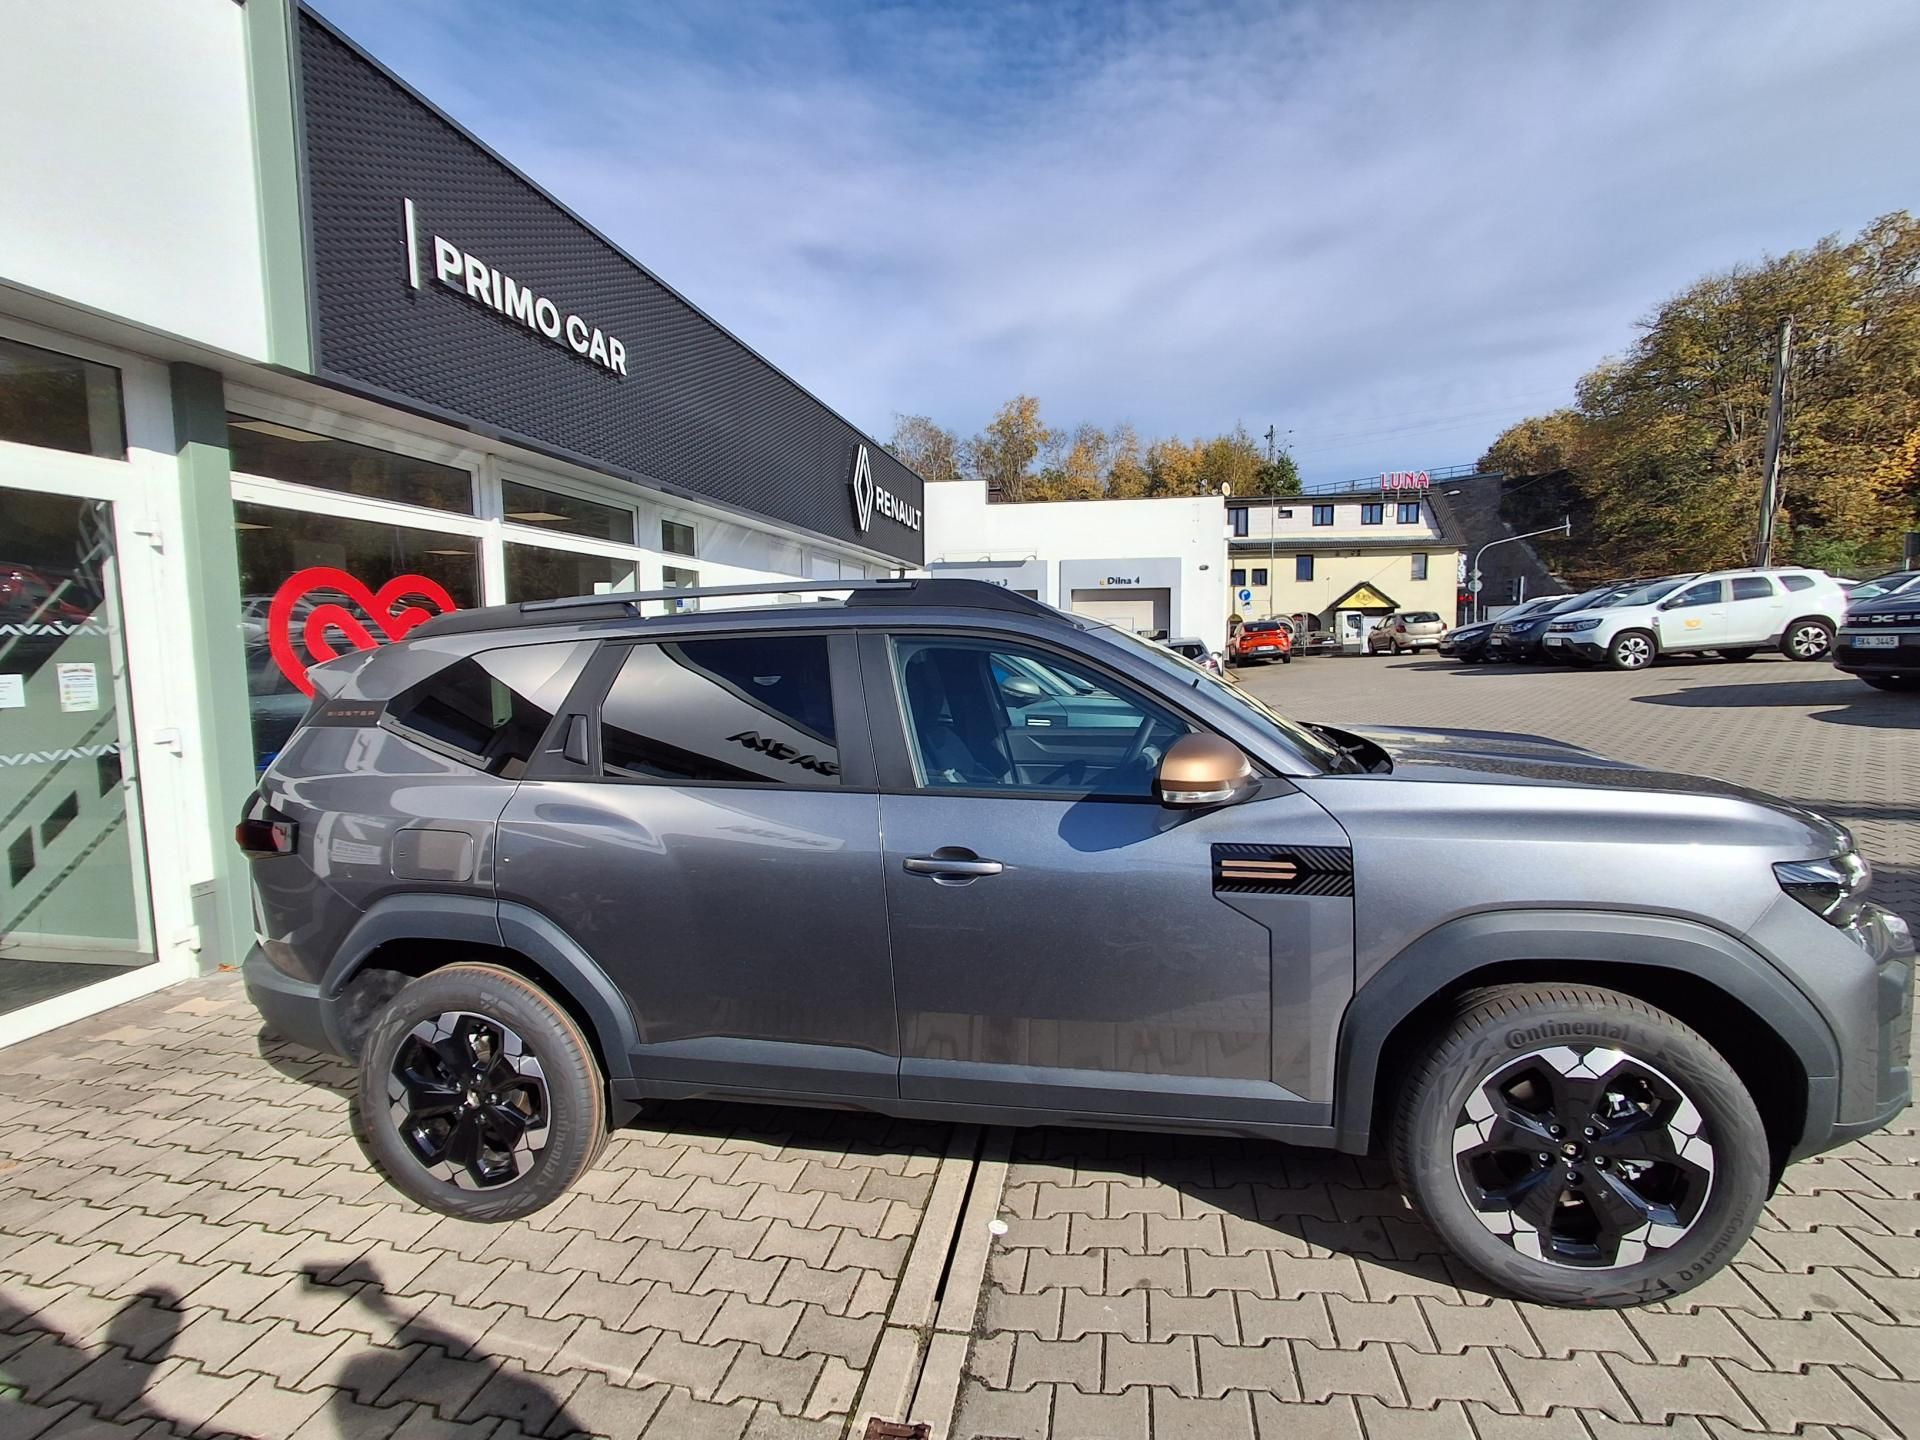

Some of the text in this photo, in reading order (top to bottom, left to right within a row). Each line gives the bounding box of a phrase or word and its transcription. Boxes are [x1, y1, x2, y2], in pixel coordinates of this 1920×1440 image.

[434, 235, 628, 376] PRIMO CAR
[1380, 470, 1429, 490] LUNA
[876, 485, 921, 532] RENAULT
[1133, 575, 1141, 585] 4
[1504, 1019, 1630, 1050] Continental
